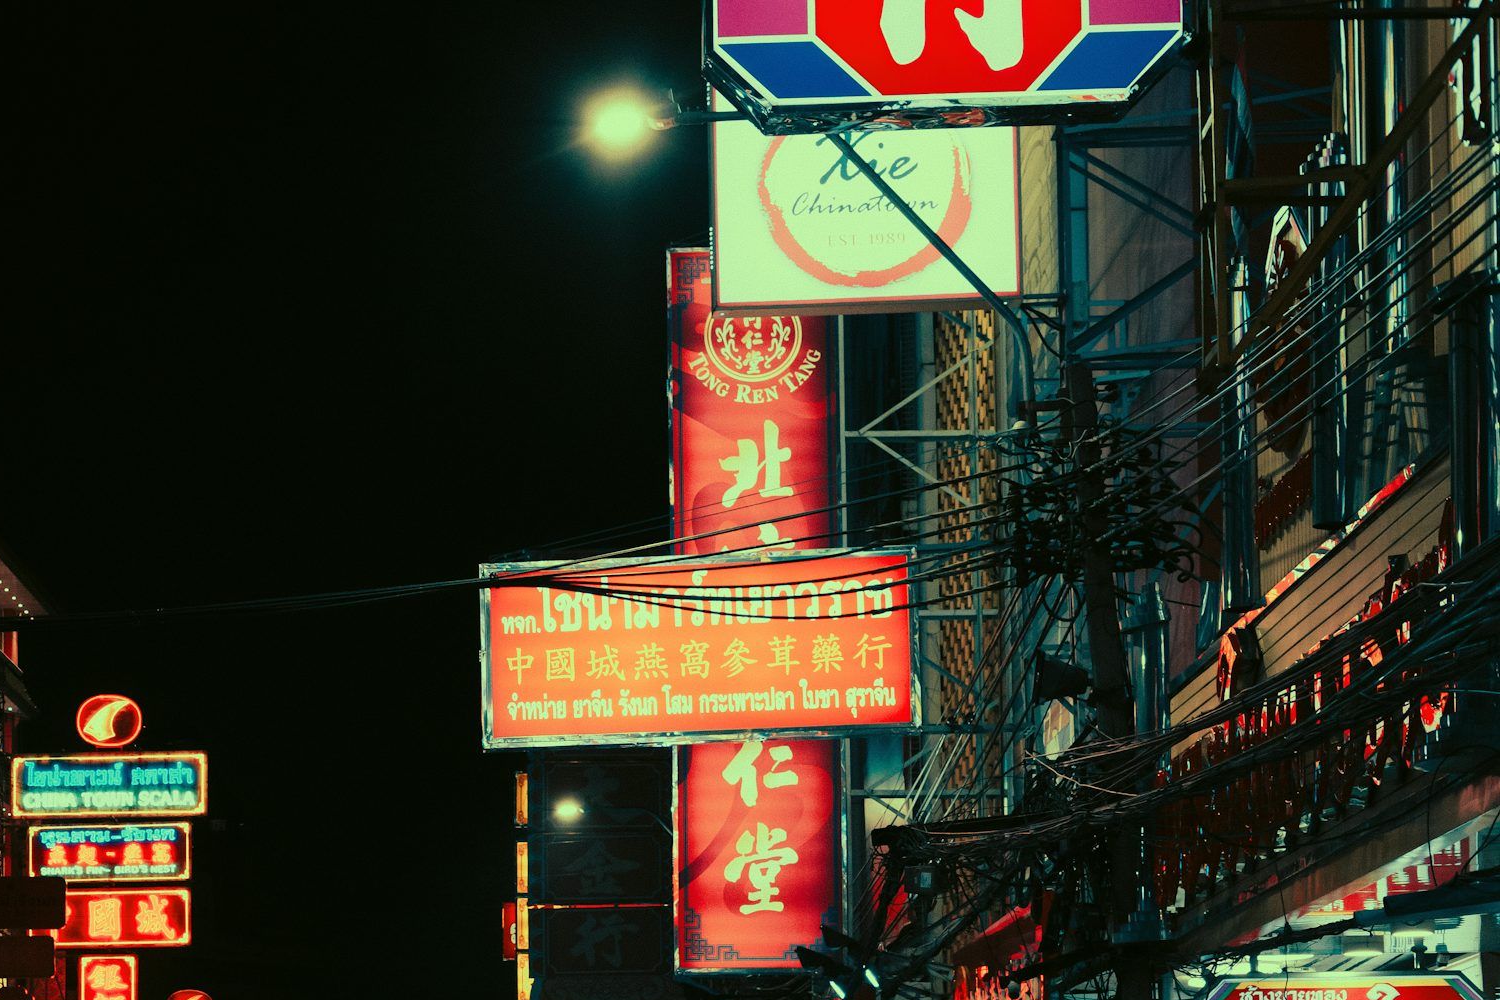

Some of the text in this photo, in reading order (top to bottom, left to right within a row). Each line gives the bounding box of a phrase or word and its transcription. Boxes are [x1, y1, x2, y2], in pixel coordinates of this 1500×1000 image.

[792, 192, 938, 216] Chinatown
[828, 231, 906, 247] EST 1989
[507, 677, 896, 720] จำหน่าย ยาจีน รังนก โสม กระเพาะปลา ใบชา สุราจีน
[23, 790, 196, 808] CHINA TOWN SCALA
[150, 864, 177, 874] NEST
[66, 894, 175, 940] 國城
